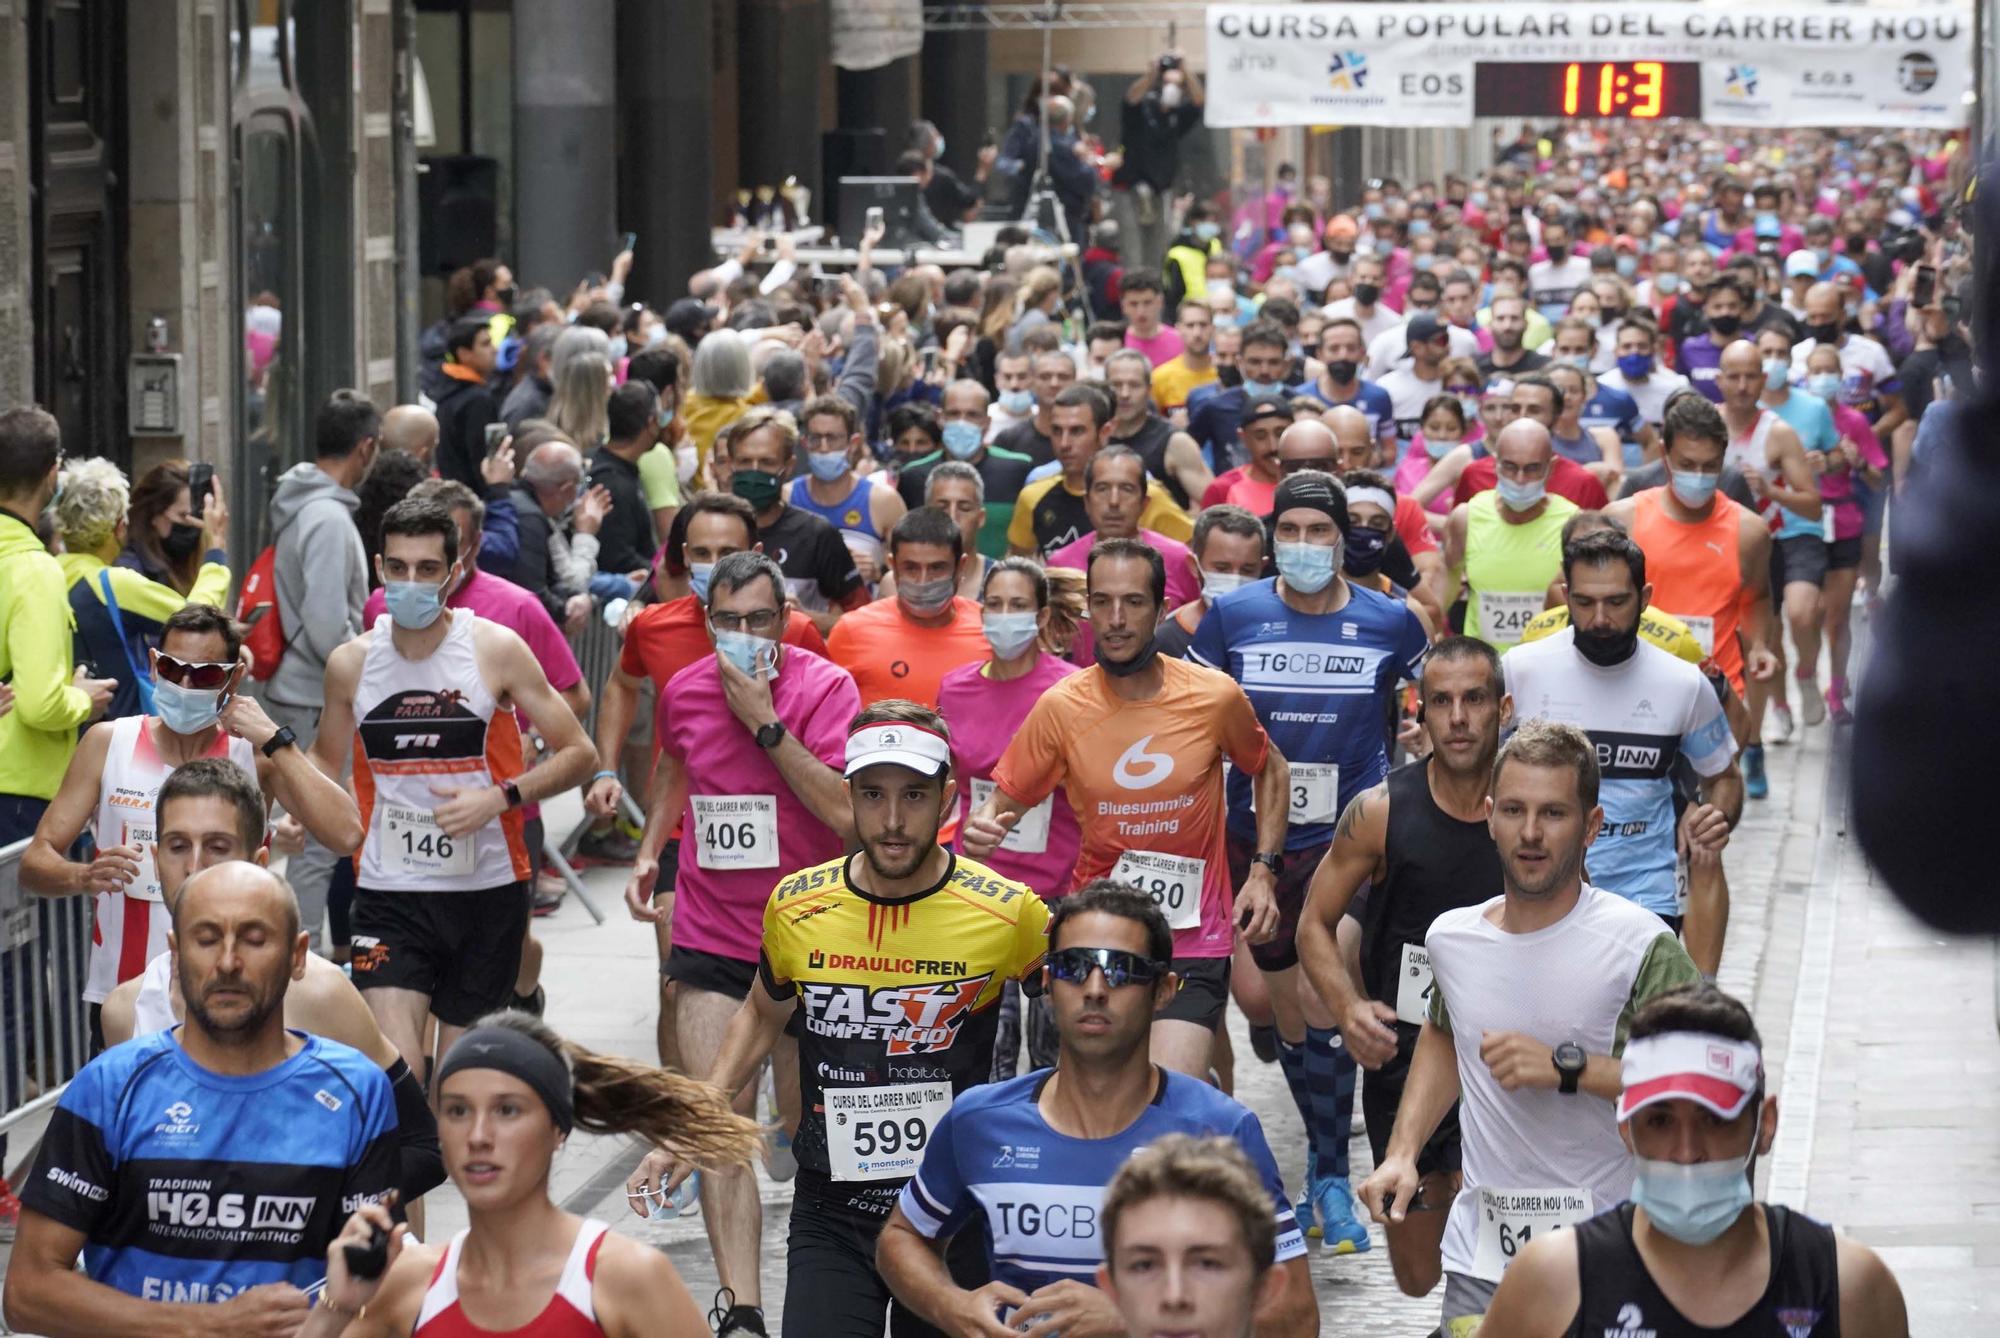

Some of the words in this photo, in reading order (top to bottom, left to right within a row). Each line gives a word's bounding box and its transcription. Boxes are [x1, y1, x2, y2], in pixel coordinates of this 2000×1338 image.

[1218, 13, 1359, 39] CURSA
[1378, 13, 1571, 39] POPULAR
[1591, 13, 1665, 37] DEL
[1684, 13, 1853, 40] CARRER
[1871, 14, 1960, 41] NOU
[1401, 74, 1464, 96] EOS
[1493, 610, 1533, 629] 248
[1258, 653, 1322, 674] TGCB
[1325, 656, 1364, 673] INN
[394, 705, 441, 718] PARRA
[1617, 747, 1659, 767] INN
[109, 795, 152, 809] PARRA
[116, 787, 145, 797] esports
[1292, 786, 1308, 809] 3
[388, 808, 404, 819] CURSA
[406, 811, 415, 822] DEL
[417, 813, 434, 824] CARRE
[716, 801, 738, 812] CARRER
[740, 801, 752, 811] NOU
[754, 801, 770, 811] 10km
[1098, 795, 1194, 816] Bluesummits
[132, 829, 152, 841] CURSA
[705, 822, 756, 849] 406
[1118, 818, 1180, 836] Training
[402, 830, 453, 858] 146
[1152, 857, 1176, 871] CARRER
[777, 865, 844, 902] FAST
[950, 867, 1025, 904] FAST
[1131, 875, 1184, 909] 180
[829, 955, 967, 976] DRAULICFREN
[803, 984, 958, 1028] FAST
[833, 1095, 856, 1109] CURSA
[858, 1095, 872, 1108] DEL
[873, 1092, 904, 1108] CARRER
[906, 1090, 921, 1104] NOU
[924, 1089, 944, 1103] 10km
[854, 1117, 927, 1157] 599
[871, 1157, 914, 1169] montepio
[150, 1179, 212, 1190] TRADEINN
[148, 1192, 246, 1228] 140.6
[252, 1196, 316, 1230] INN
[1497, 1196, 1509, 1210] DEL
[1511, 1196, 1541, 1210] CARRER
[1544, 1196, 1561, 1210] NOU
[1563, 1196, 1585, 1209] 10km
[996, 1203, 1095, 1238] TGCB
[1500, 1223, 1561, 1257] 61
